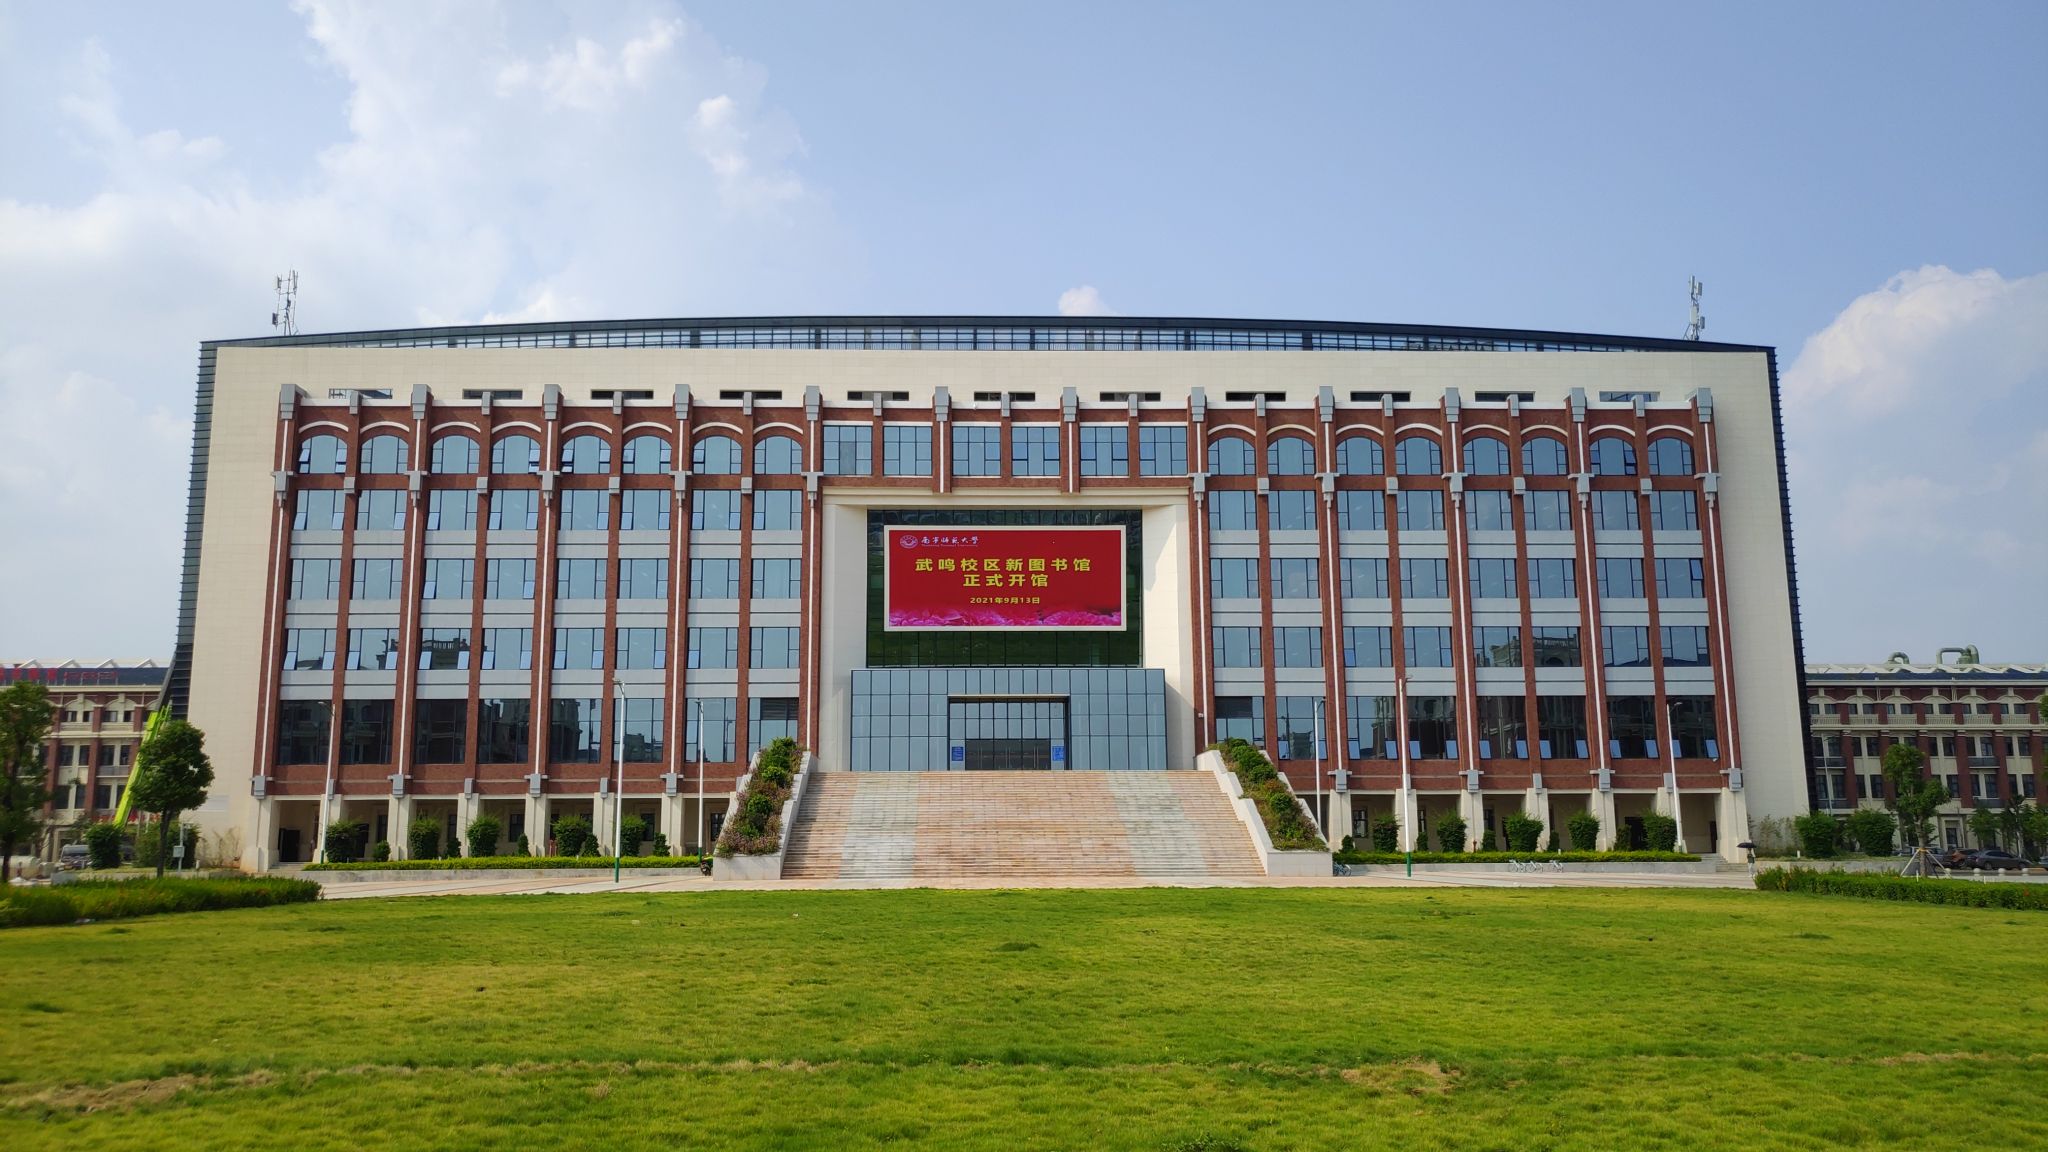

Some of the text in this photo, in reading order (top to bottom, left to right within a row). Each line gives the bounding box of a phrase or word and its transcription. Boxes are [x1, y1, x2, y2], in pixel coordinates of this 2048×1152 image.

[915, 558, 1091, 572] 武鸣校区新图书馆
[963, 574, 1049, 587] 正式开馆
[970, 597, 1041, 605] 2021年9月13日
